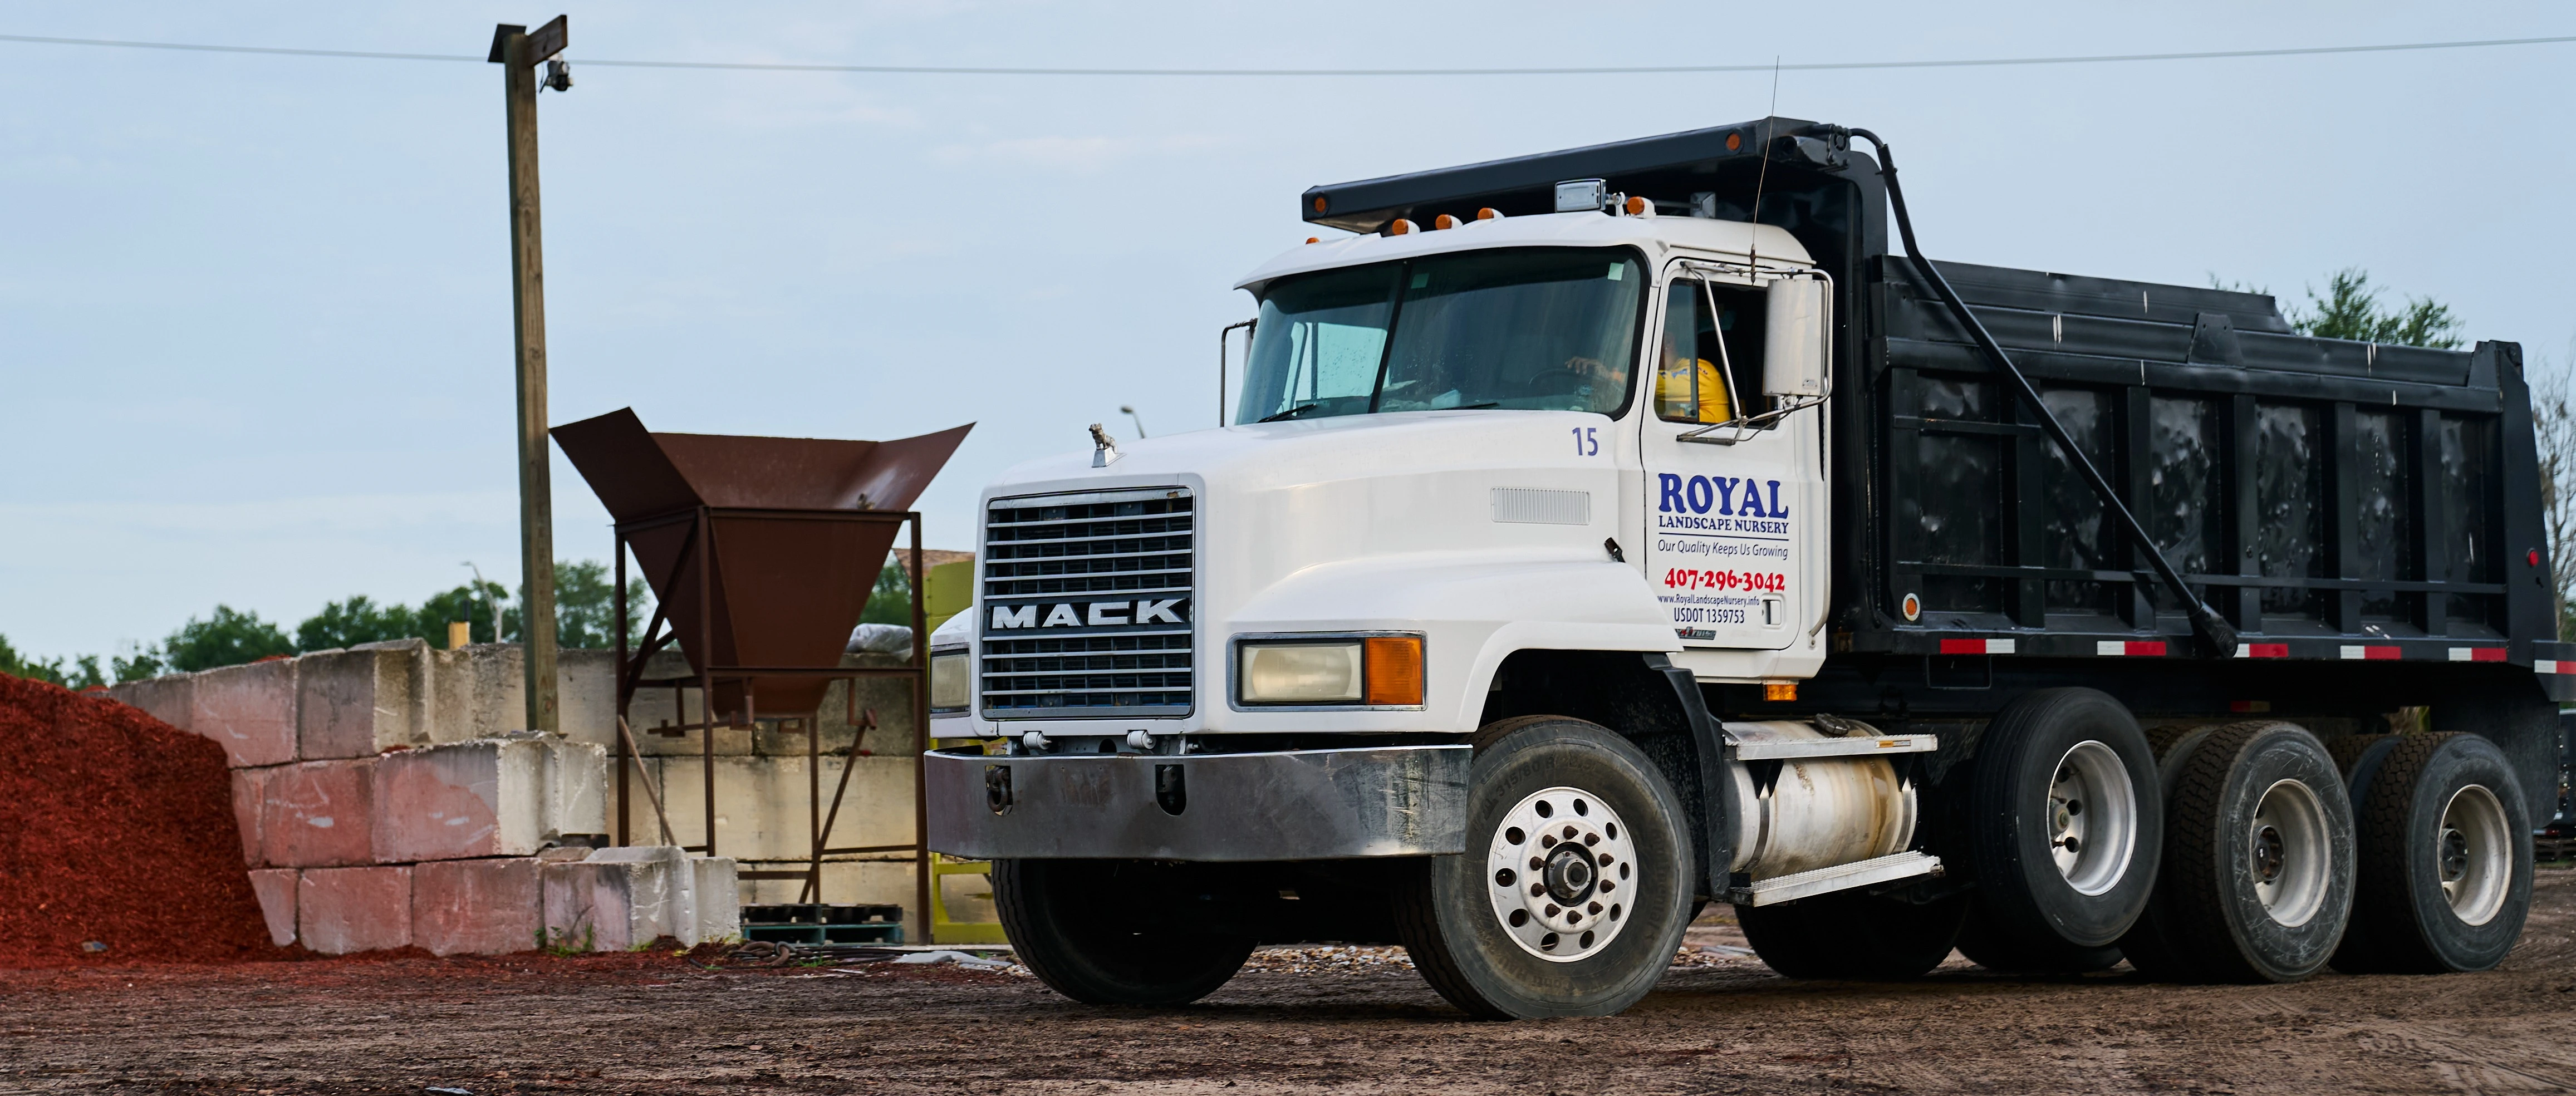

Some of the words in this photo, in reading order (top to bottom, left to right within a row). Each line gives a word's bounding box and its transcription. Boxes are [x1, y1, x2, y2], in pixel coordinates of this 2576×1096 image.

[1572, 427, 1598, 456] 15
[1658, 473, 1789, 519] ROYAL
[1659, 515, 1732, 530] LANDSCAPE
[1734, 519, 1789, 534] NURSERY
[1658, 539, 1675, 552] Our
[1677, 540, 1711, 557] Quality
[1712, 542, 1738, 558] Keeps
[1740, 543, 1750, 556] Us
[1752, 544, 1788, 561] Growing
[1665, 568, 1785, 592] 407-296-3042
[1657, 593, 1760, 608] www.RoyalLandscapeNursery.info
[992, 598, 1186, 628] MACK
[1674, 607, 1704, 622] USDOT
[1706, 608, 1744, 623] 1359753
